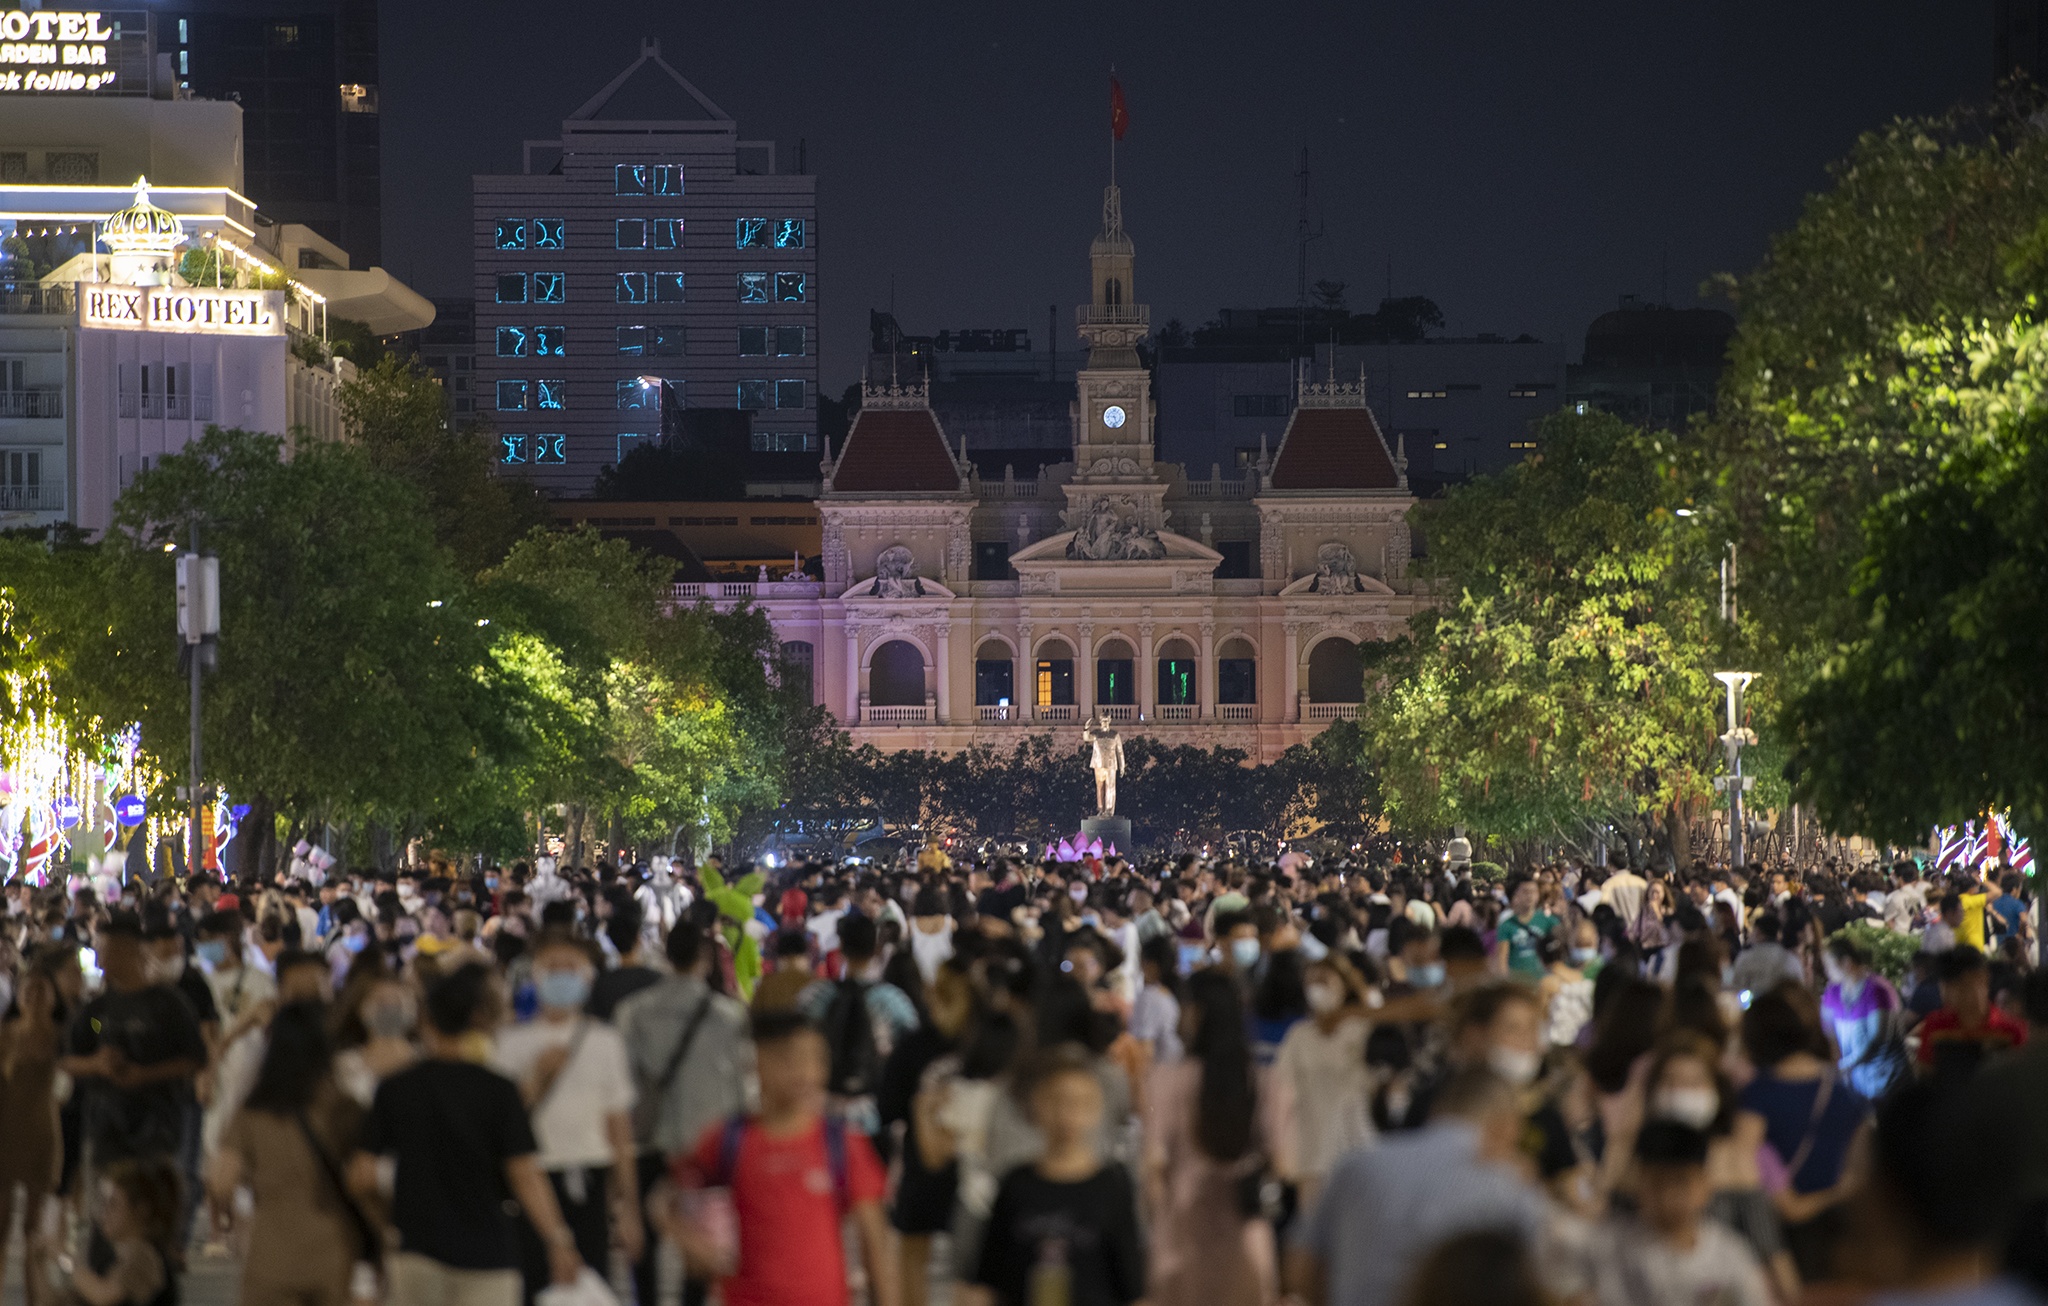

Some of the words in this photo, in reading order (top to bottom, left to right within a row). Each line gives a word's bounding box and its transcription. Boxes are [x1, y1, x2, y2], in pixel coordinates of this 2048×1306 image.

[0, 10, 112, 41] OTEL
[0, 43, 57, 64] RDEN
[62, 44, 107, 65] BAR
[90, 292, 142, 321] REX
[152, 295, 271, 326] HOTEL
